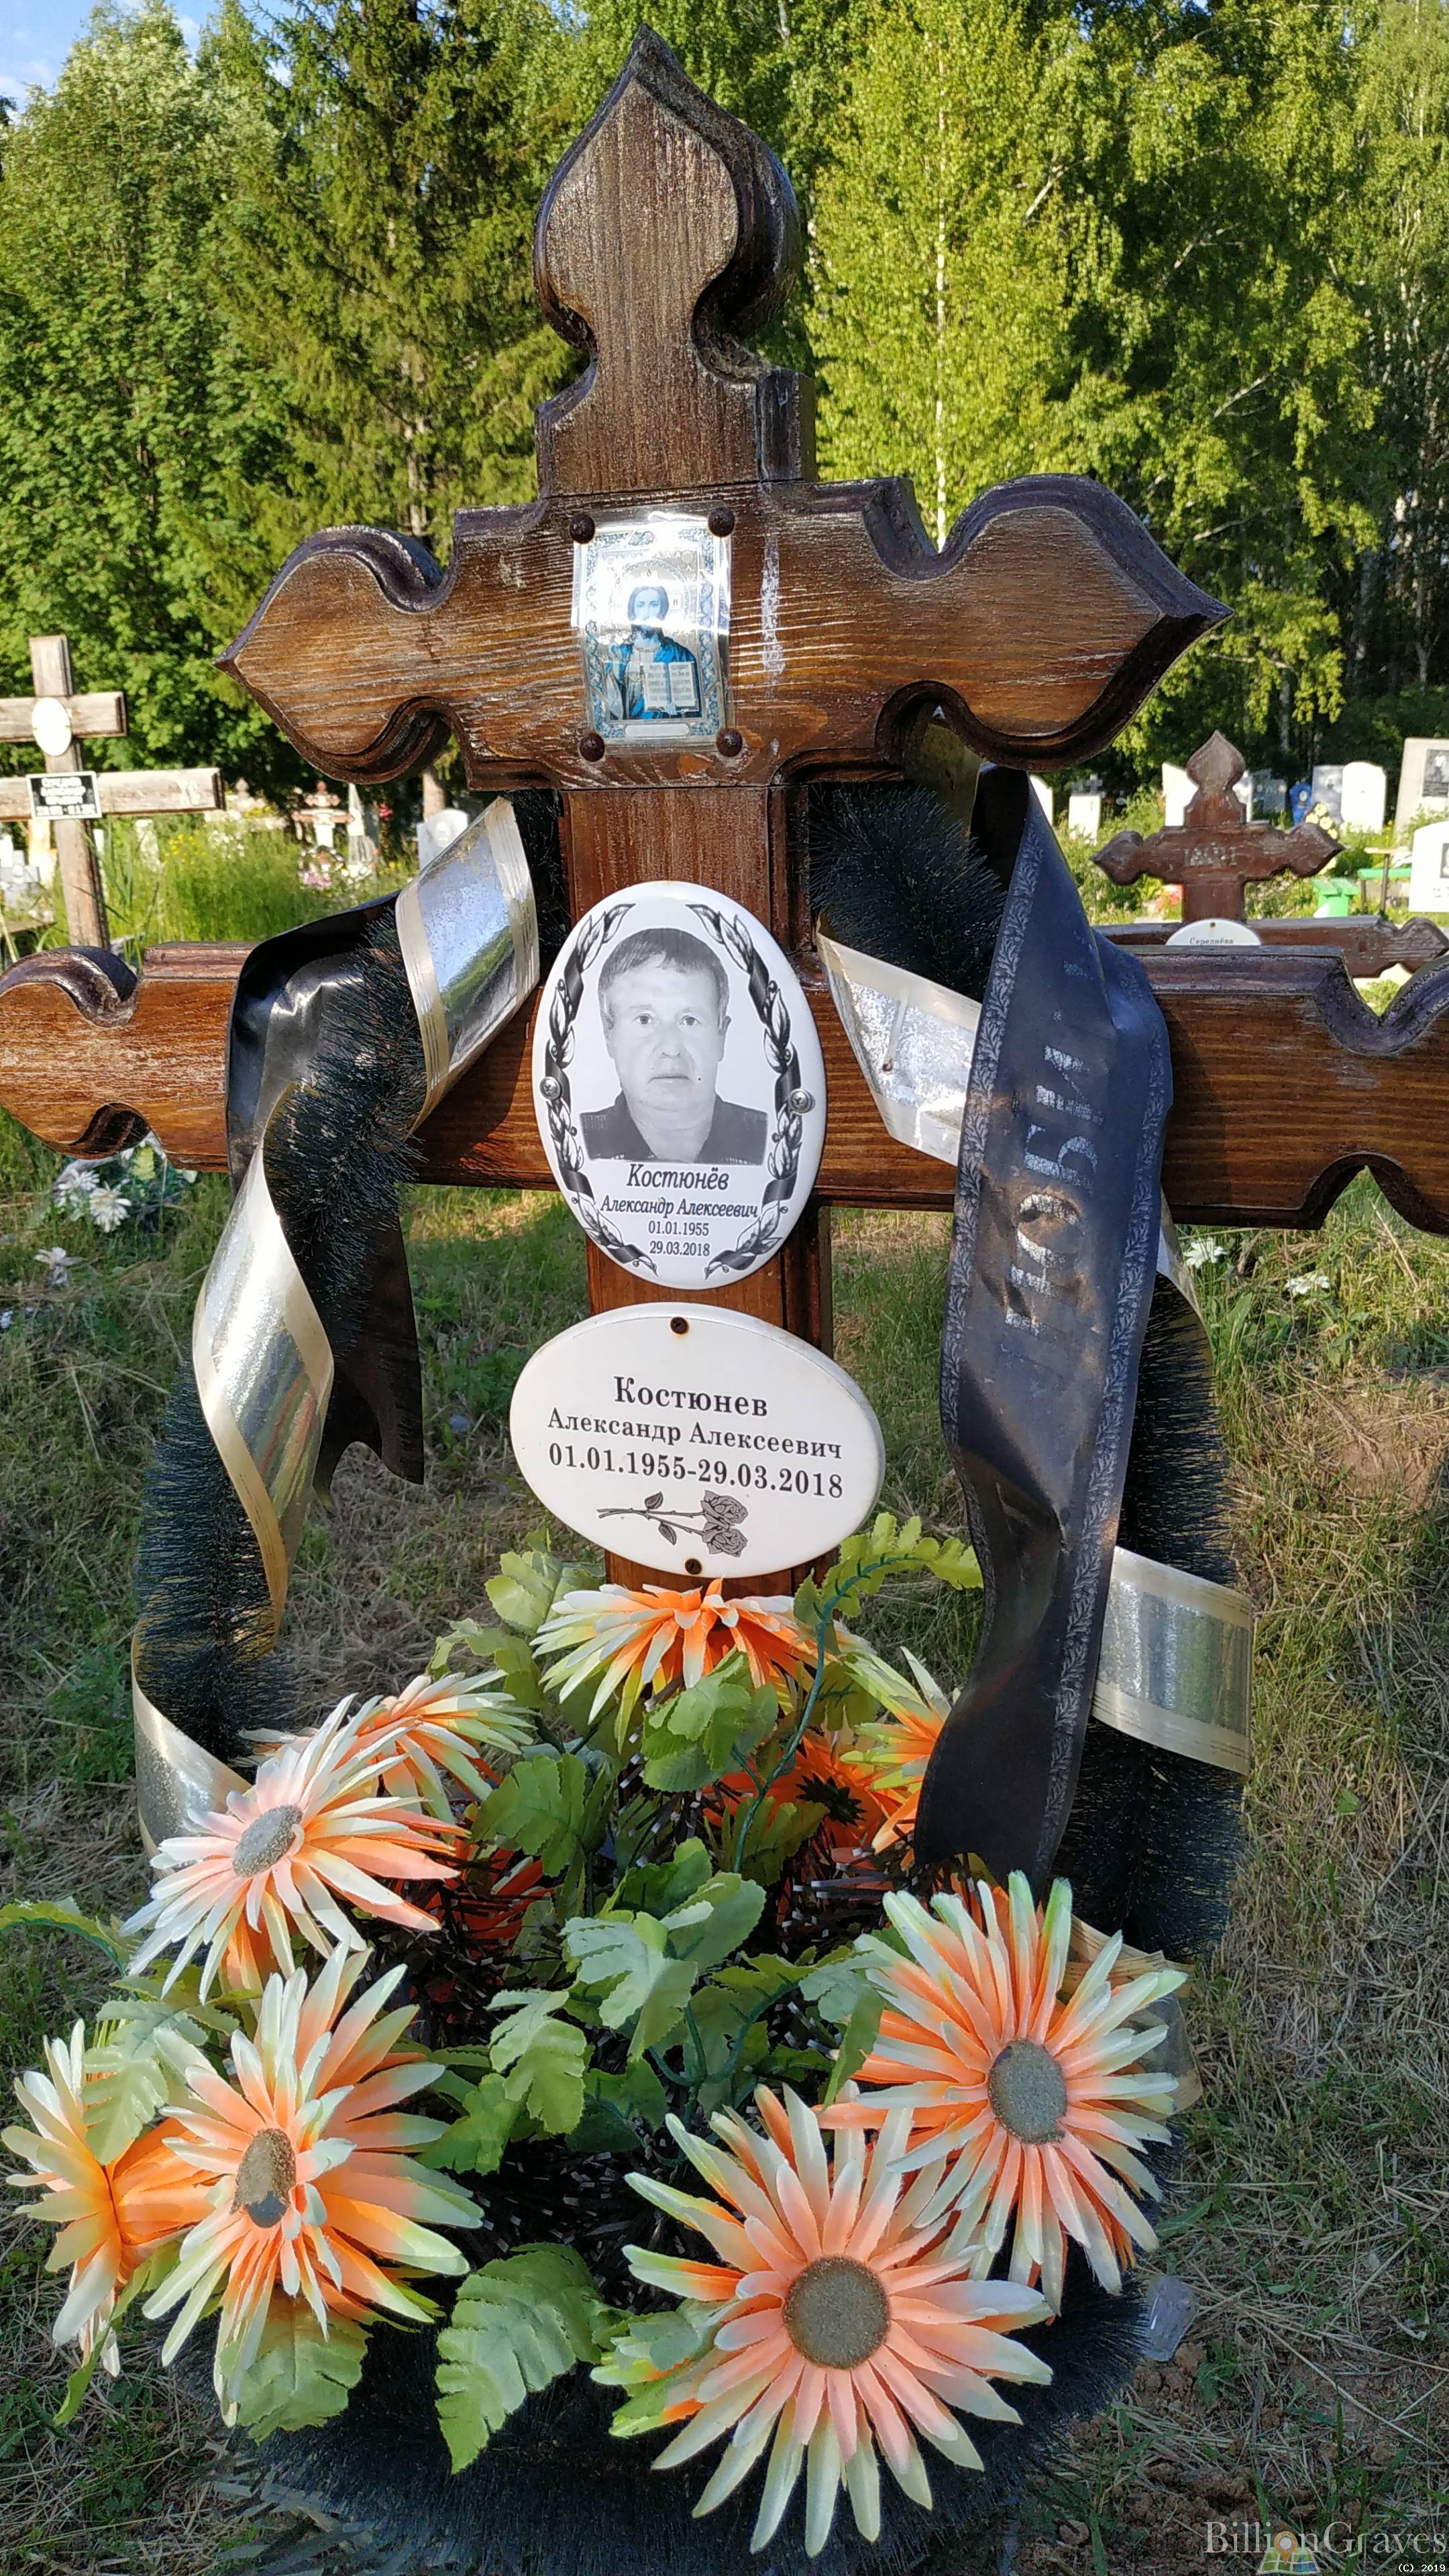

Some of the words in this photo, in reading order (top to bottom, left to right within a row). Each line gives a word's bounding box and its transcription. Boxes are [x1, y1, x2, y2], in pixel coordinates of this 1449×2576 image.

[626, 1163, 729, 1191] Костюнёв
[600, 1195, 674, 1219] Александр
[676, 1198, 759, 1218] Алексеевич
[648, 1220, 710, 1236] 01.01.1955
[649, 1240, 710, 1257] 29.03.2018
[614, 1376, 767, 1417] Костюнев
[547, 1407, 681, 1446] Александр
[688, 1421, 842, 1459] Алексеевич
[549, 1442, 843, 1499] 01.01.1955-29.03.2018
